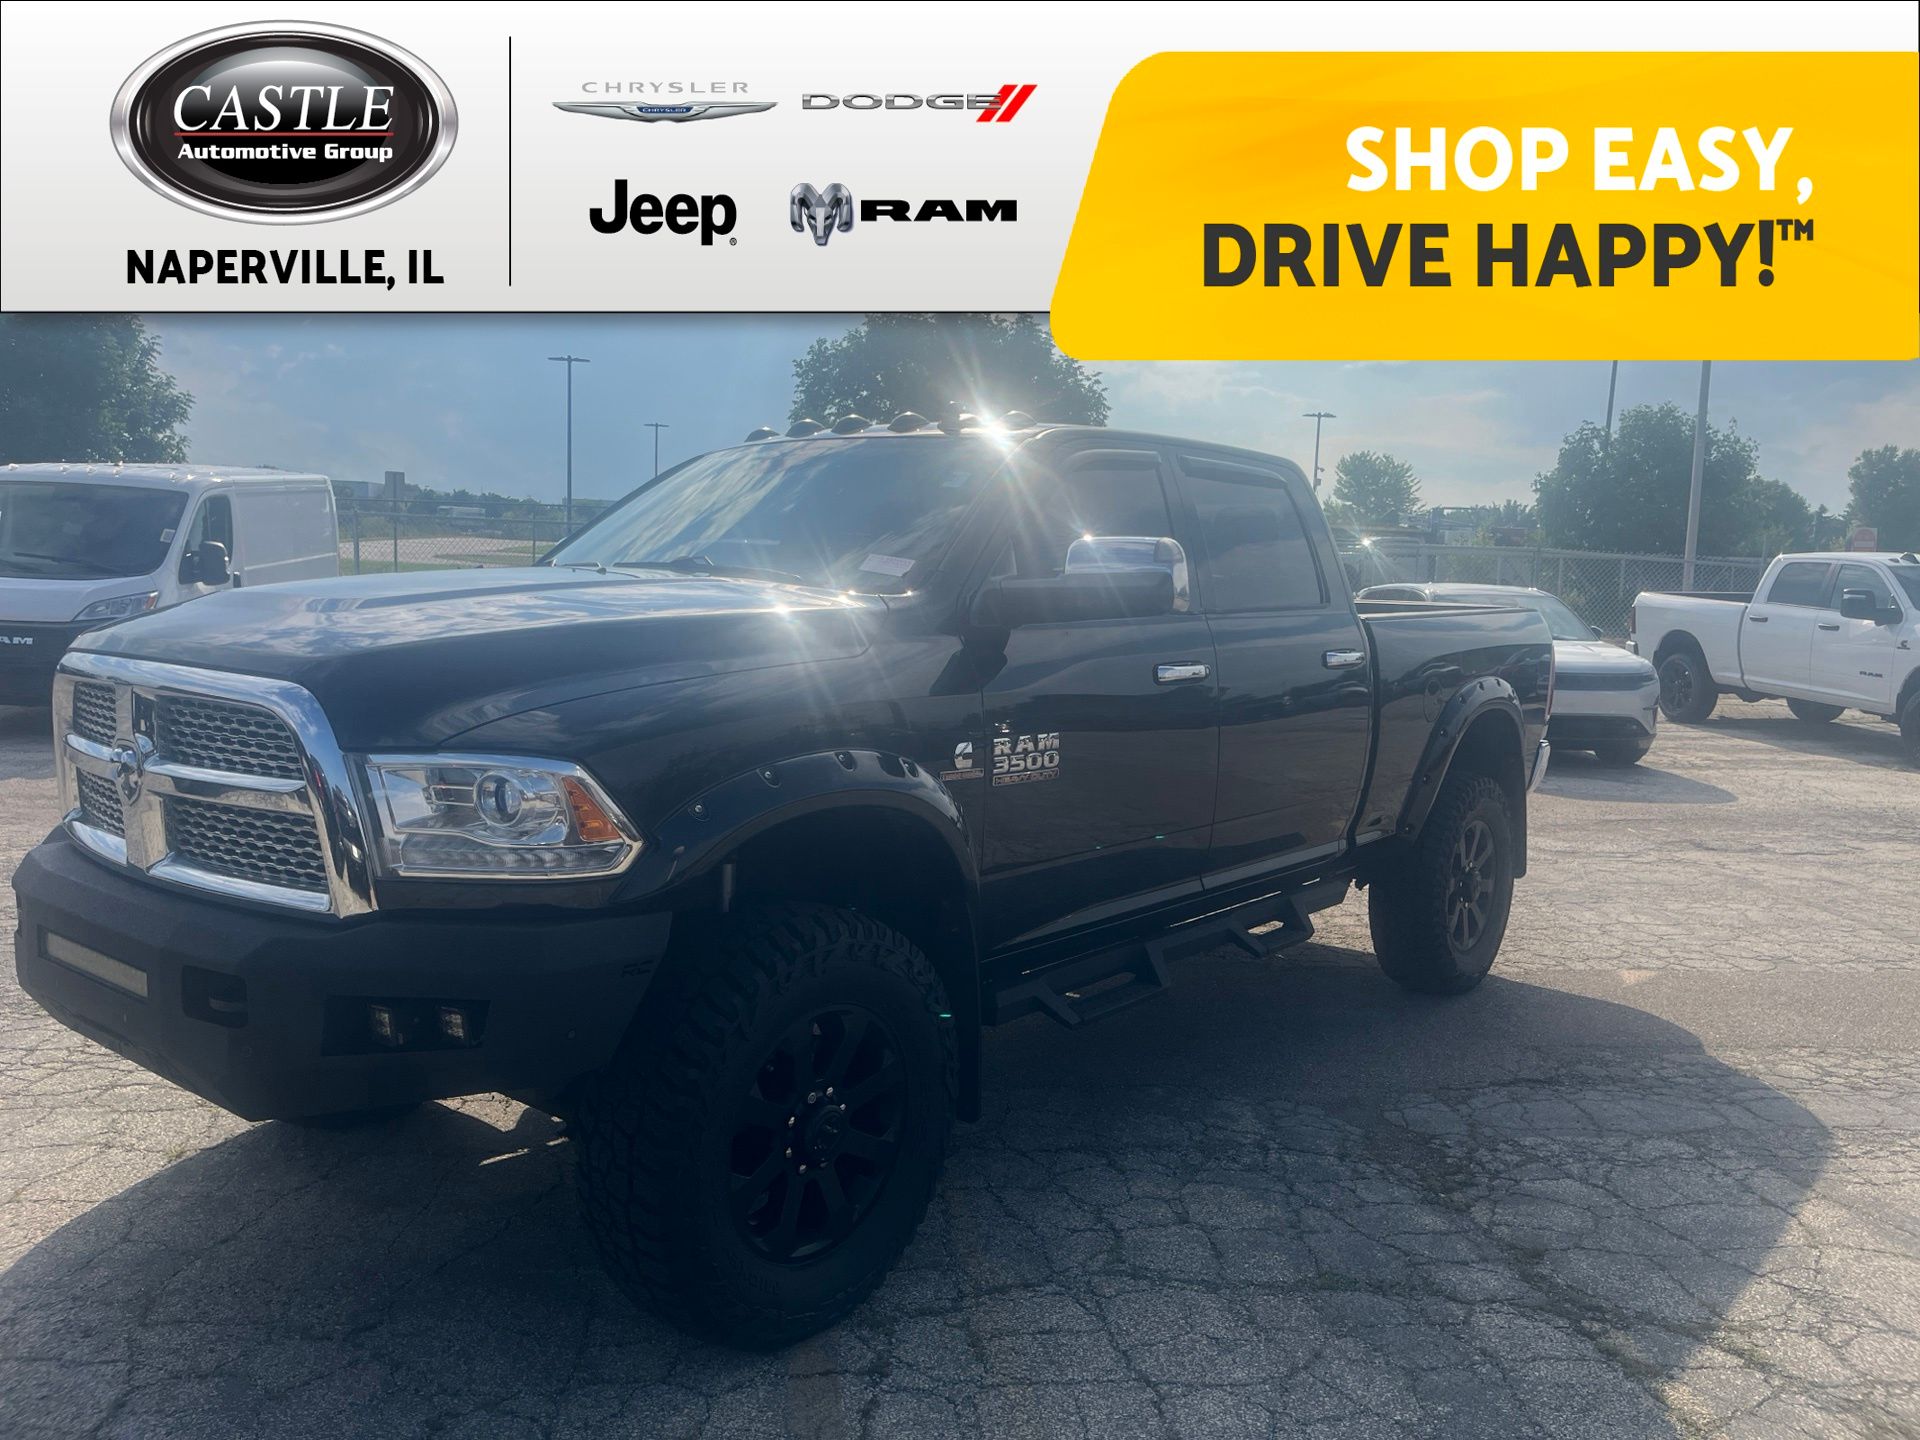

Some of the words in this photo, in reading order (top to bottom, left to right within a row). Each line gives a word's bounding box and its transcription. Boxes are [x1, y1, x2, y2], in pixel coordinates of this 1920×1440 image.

[0, 636, 33, 645] AM
[993, 733, 1060, 756] RAM
[993, 751, 1060, 774] 3500
